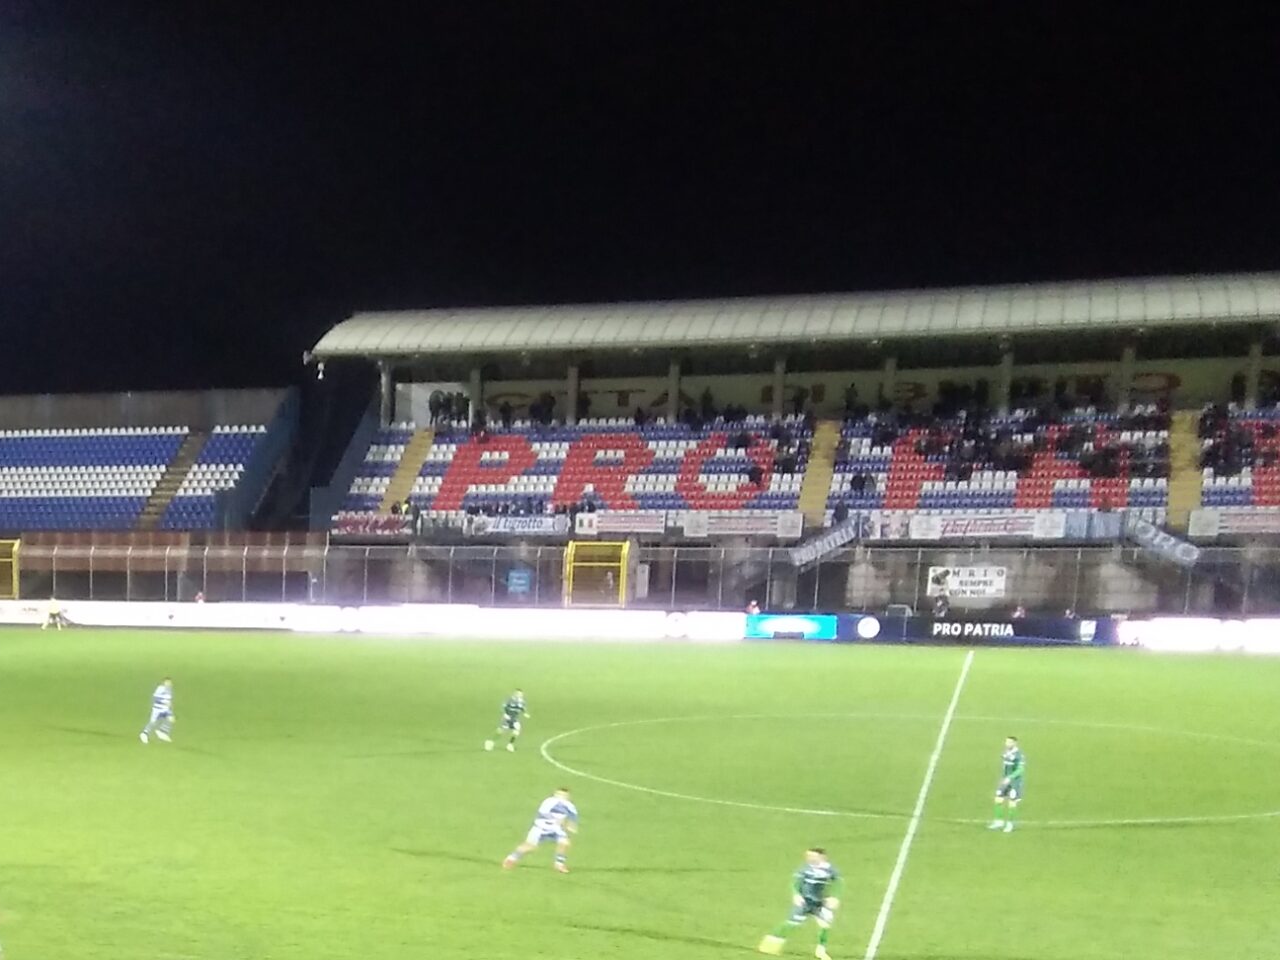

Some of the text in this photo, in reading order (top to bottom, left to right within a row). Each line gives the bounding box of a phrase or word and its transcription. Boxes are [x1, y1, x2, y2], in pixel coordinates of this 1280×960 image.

[433, 432, 778, 510] PRO
[933, 622, 1015, 637] PRO PATRIA
